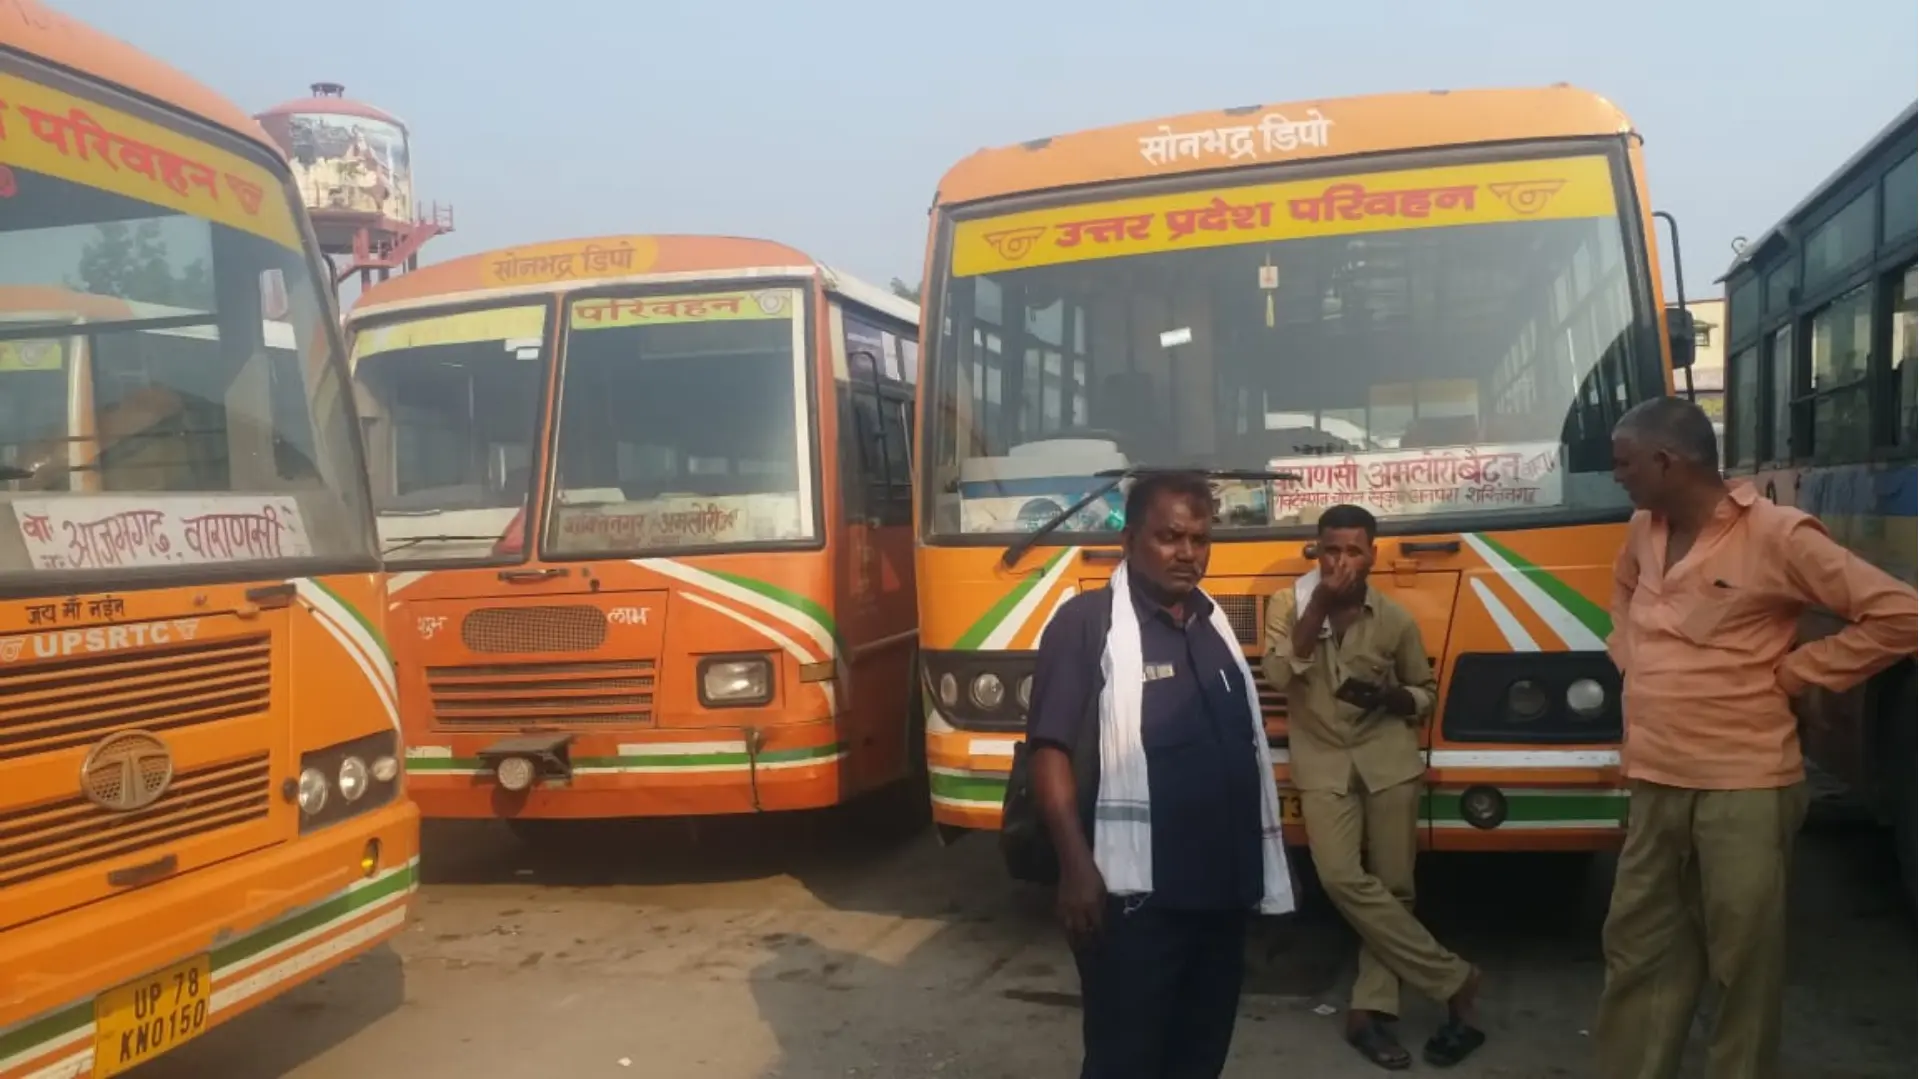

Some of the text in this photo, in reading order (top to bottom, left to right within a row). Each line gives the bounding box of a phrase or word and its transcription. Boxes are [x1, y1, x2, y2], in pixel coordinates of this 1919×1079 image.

[16, 103, 219, 202] परिवहन
[1137, 108, 1335, 167] सोनभद्र डिपो
[1053, 182, 1478, 248] उत्तर प्रदेश परिवहन
[493, 241, 637, 282] सोनभद्र डिपो
[576, 296, 744, 324] परिवहन
[26, 604, 56, 626] जय
[607, 606, 651, 627] लाभ
[33, 619, 171, 659] UPSRTC
[134, 966, 199, 1020] UP 78
[119, 998, 206, 1064] KN0150
